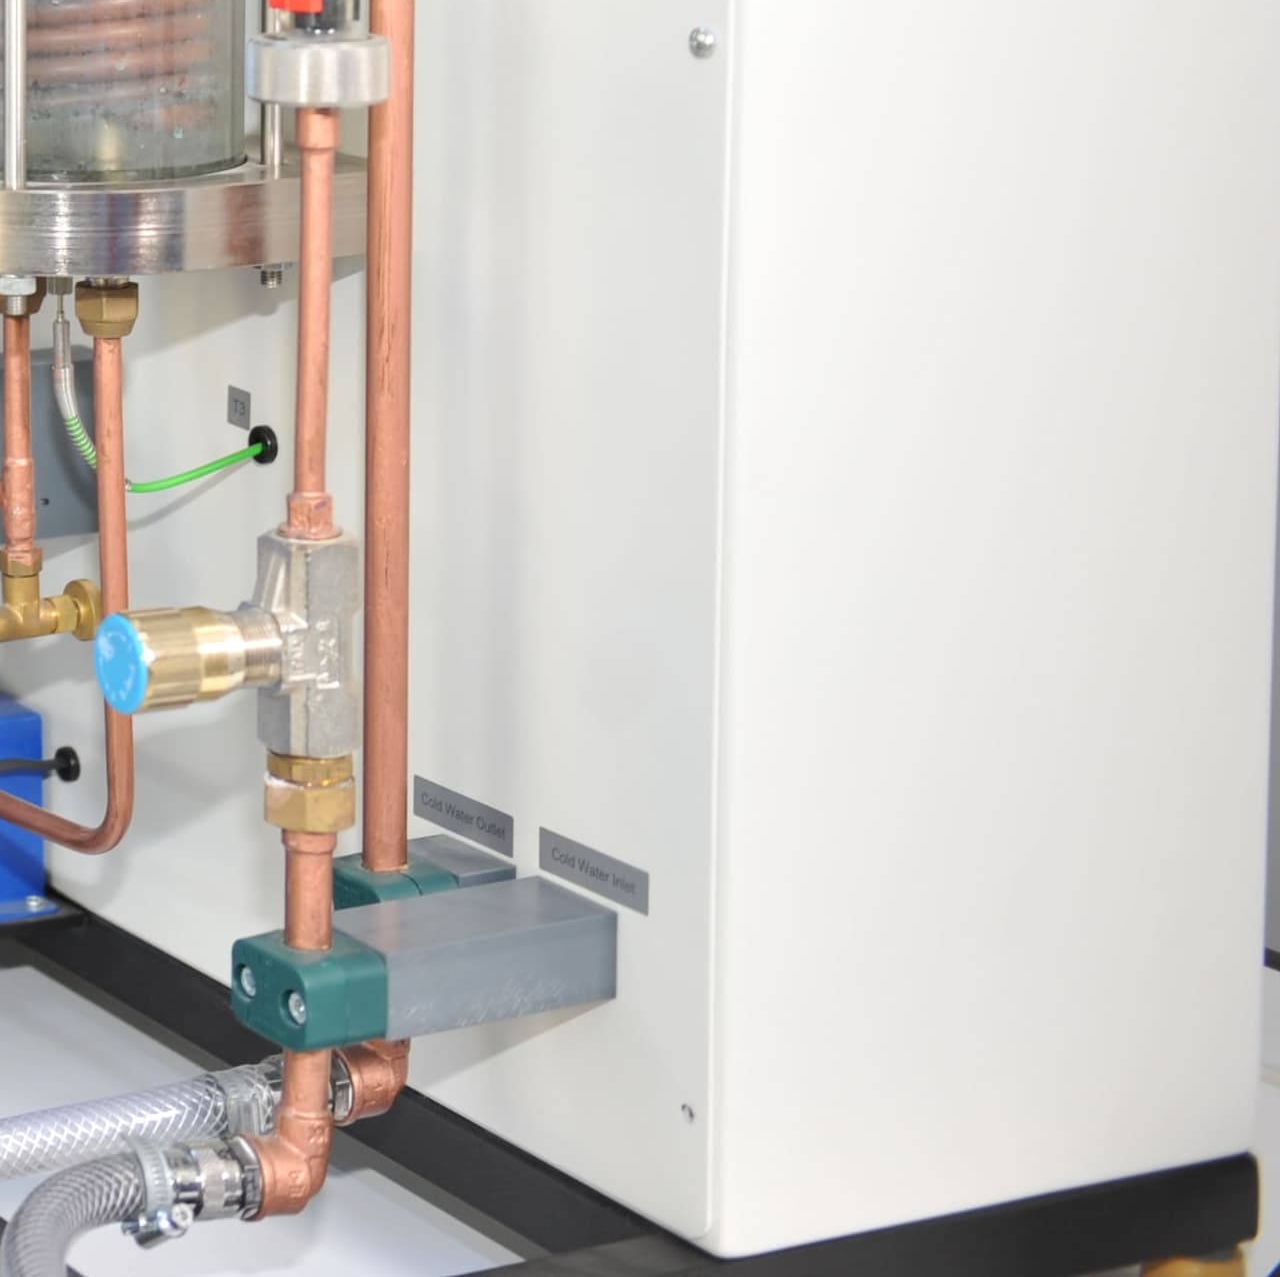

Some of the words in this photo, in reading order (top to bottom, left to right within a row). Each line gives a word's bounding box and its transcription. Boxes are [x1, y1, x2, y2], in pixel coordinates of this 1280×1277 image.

[421, 793, 443, 813] Cold
[444, 800, 474, 826] Water
[476, 816, 506, 842] Outlet
[551, 846, 576, 870] Cold
[578, 857, 610, 883] Water
[612, 871, 636, 894] Inlet
